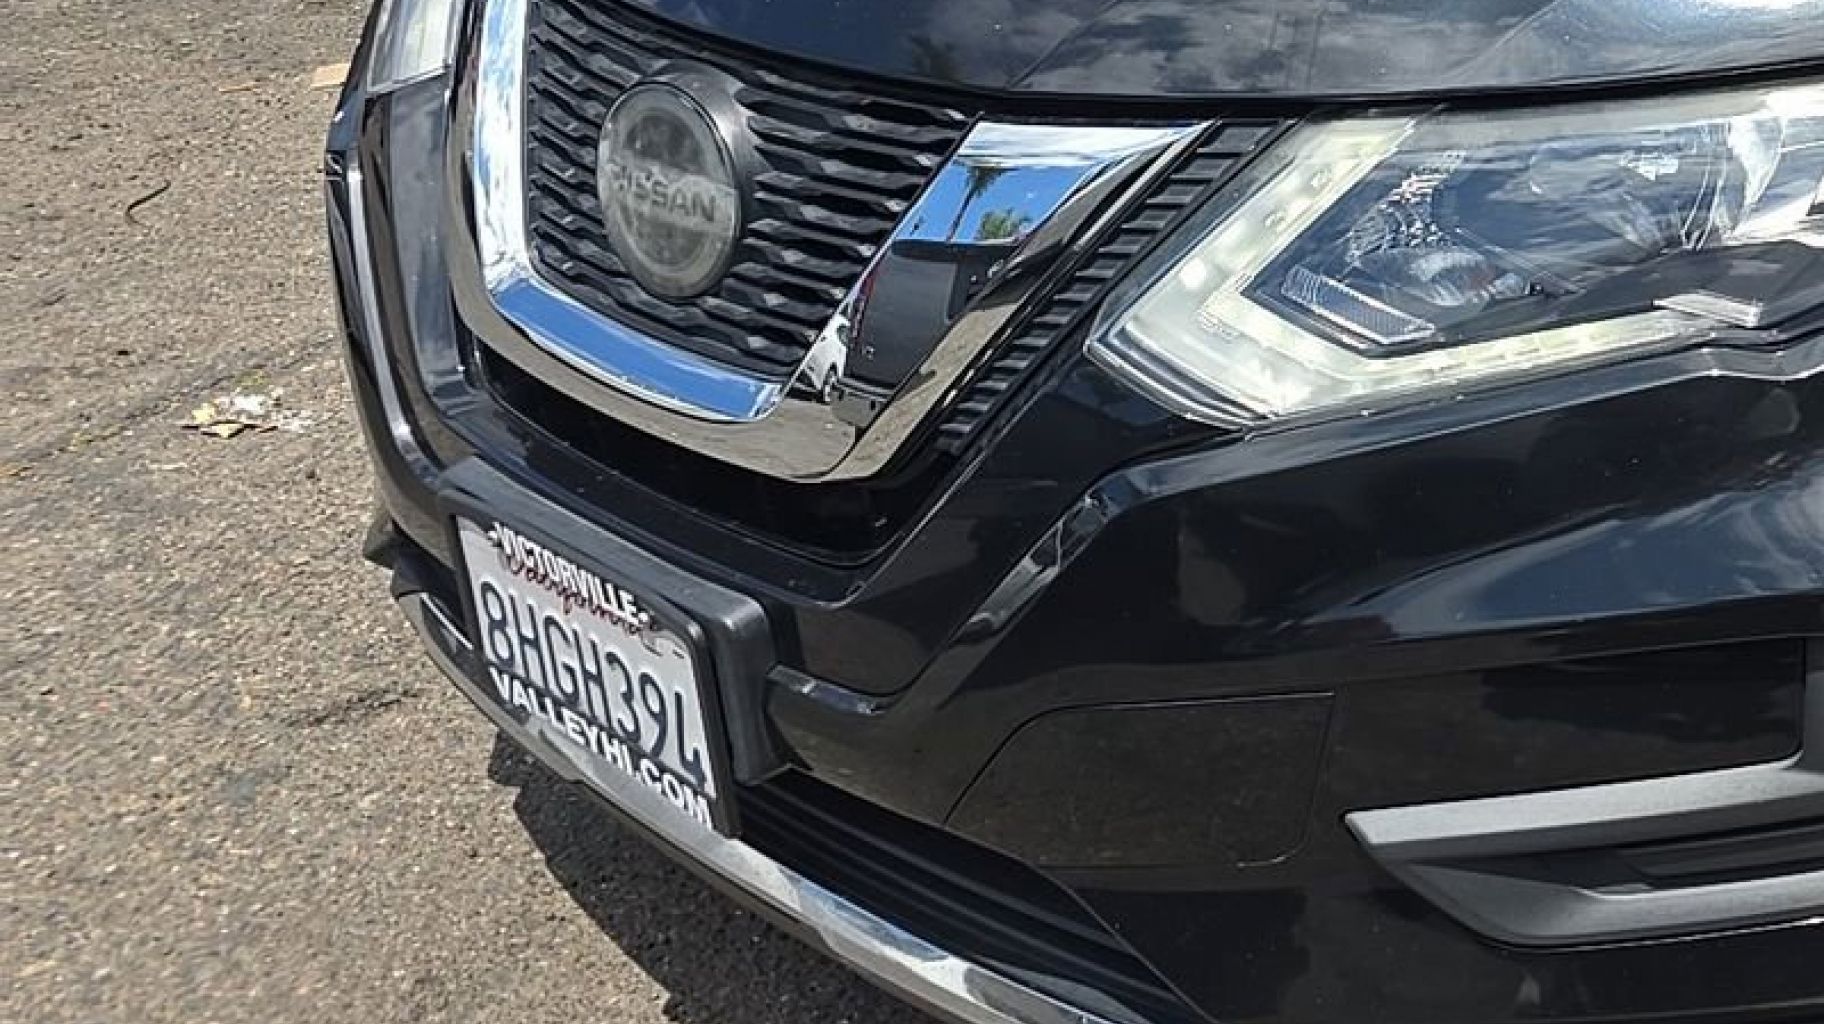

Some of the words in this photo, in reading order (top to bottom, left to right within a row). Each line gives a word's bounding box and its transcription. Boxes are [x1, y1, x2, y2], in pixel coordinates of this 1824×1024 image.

[611, 163, 717, 223] NISSAN
[496, 522, 641, 626] VICTORVILLE
[480, 580, 706, 790] 8HGH394
[490, 667, 713, 832] VALLEYHI.COM
